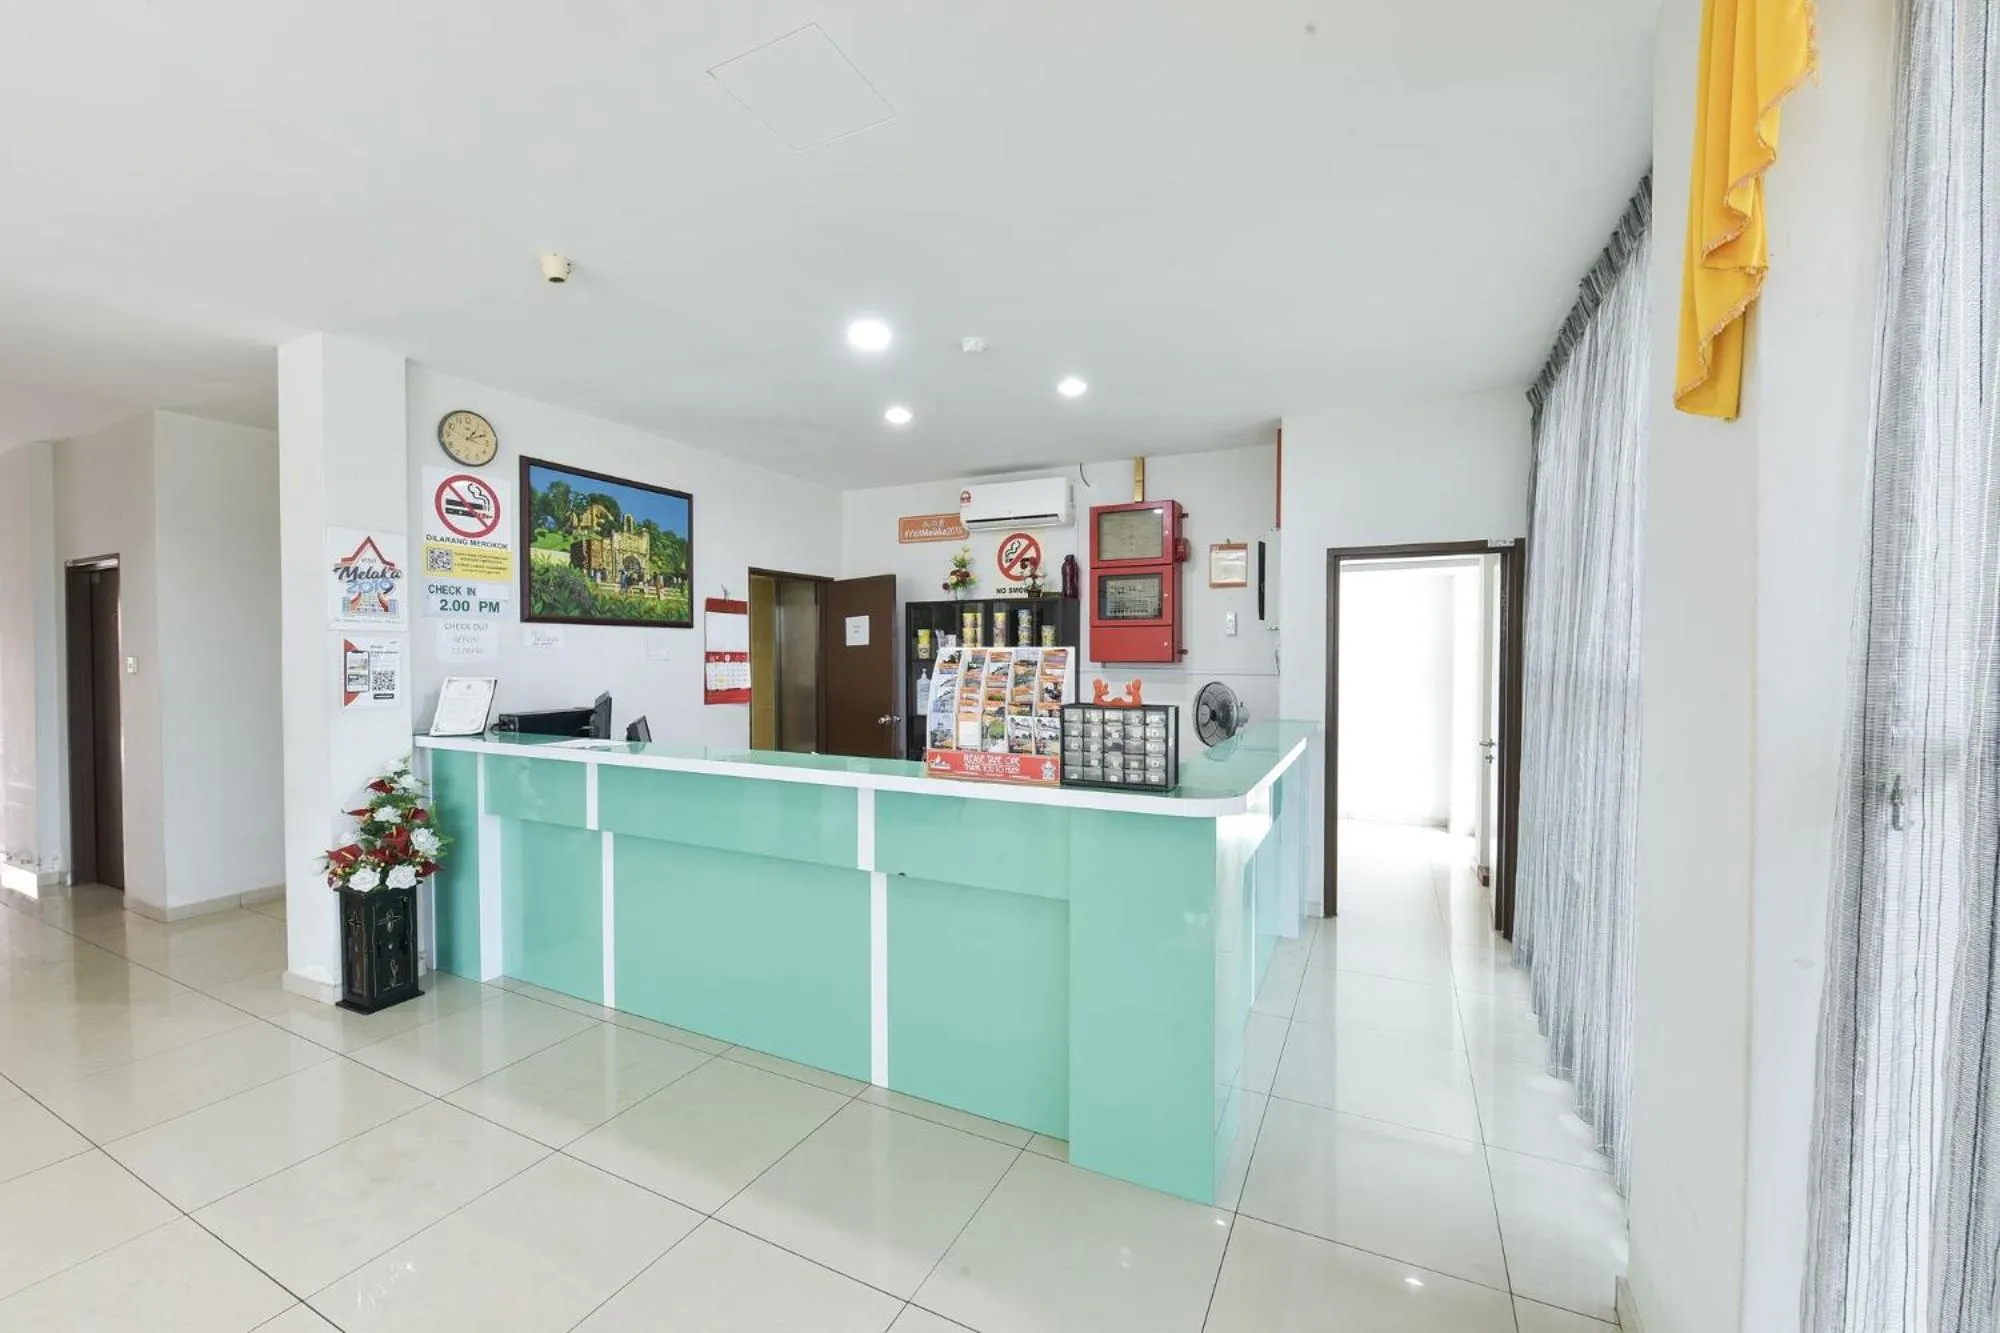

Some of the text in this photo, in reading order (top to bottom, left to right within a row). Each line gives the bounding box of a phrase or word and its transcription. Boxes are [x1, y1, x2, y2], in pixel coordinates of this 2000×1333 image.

[426, 534, 509, 550] DILARANG MEROKOK
[333, 566, 401, 583] Melaka
[346, 580, 394, 595] 2019
[428, 584, 476, 597] CHECK IN
[440, 599, 500, 613] 2.00 PM
[444, 622, 488, 632] CHECK OUT
